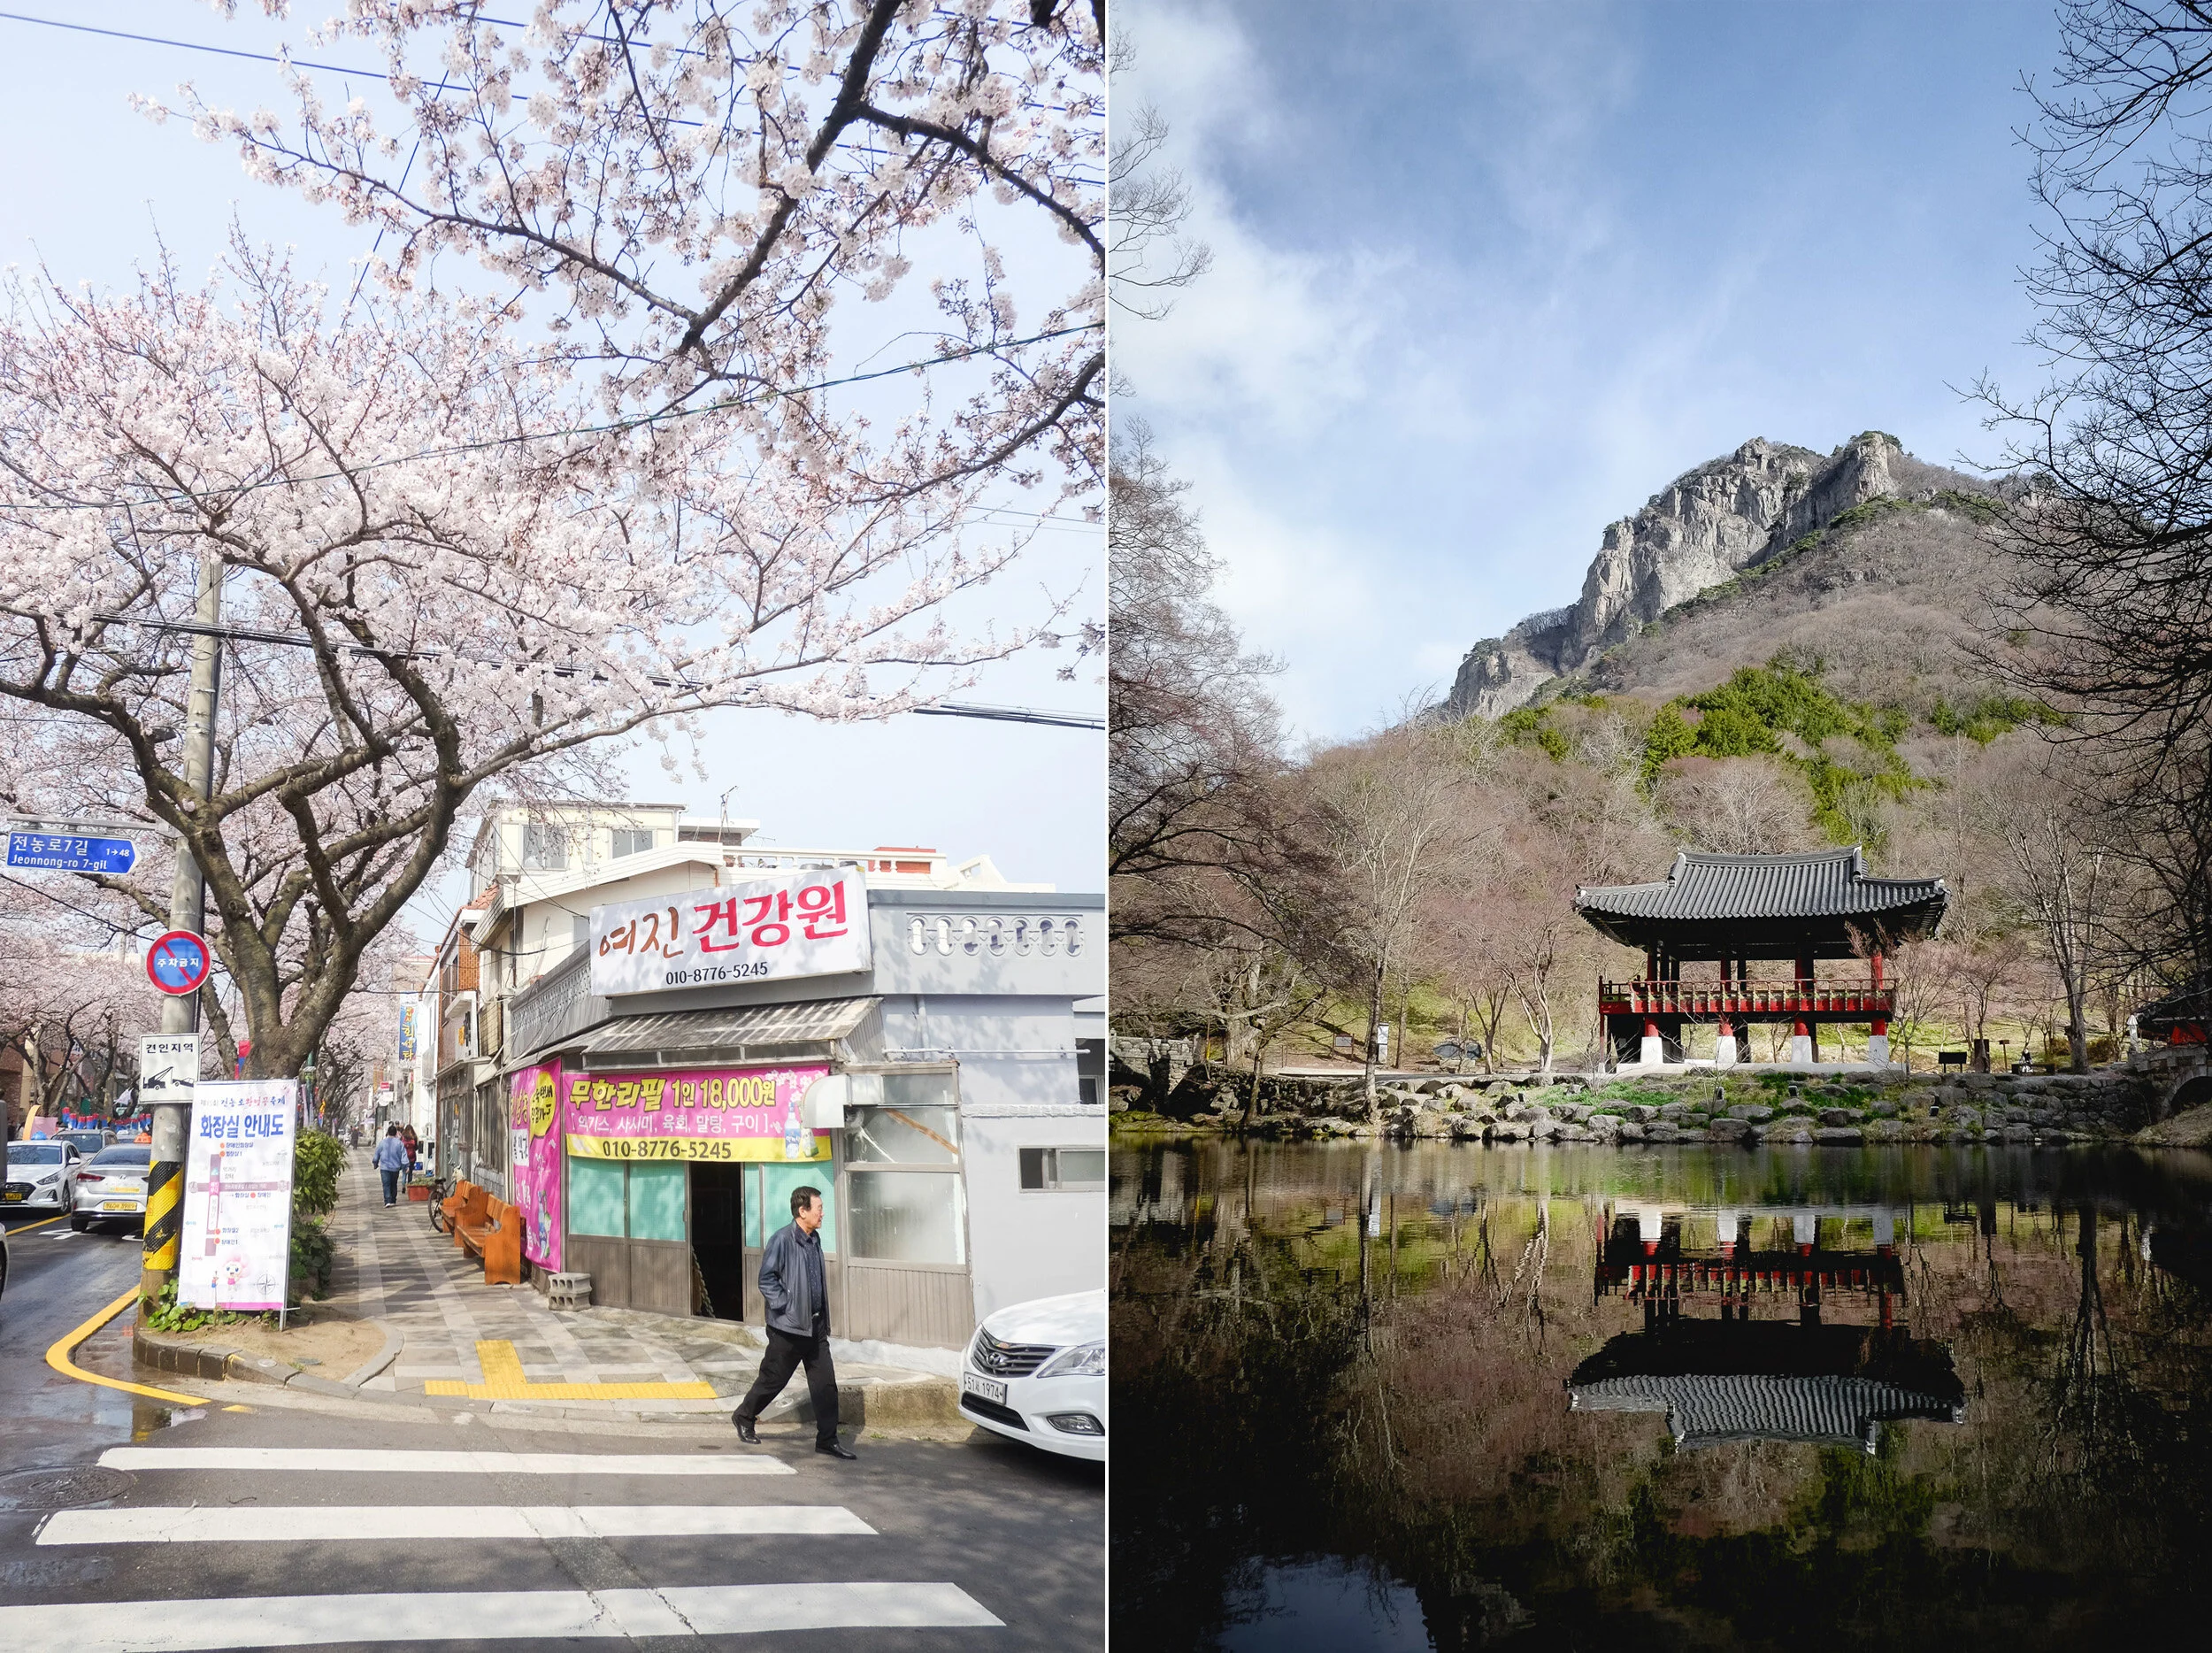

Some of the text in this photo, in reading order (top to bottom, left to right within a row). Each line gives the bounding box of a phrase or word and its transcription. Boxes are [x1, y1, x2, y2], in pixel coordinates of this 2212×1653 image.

[13, 835, 88, 856] 전농로7길
[11, 854, 107, 872] Jeonnong-ro 7-gil
[599, 880, 849, 958] 여진 건강원
[157, 957, 199, 968] 주차금지
[665, 961, 769, 986] 010-8776-5245
[146, 1042, 193, 1054] 견인지역
[568, 1077, 666, 1111] 무한리필
[671, 1078, 696, 1108] 1인
[699, 1075, 777, 1113] 18,000원
[199, 1113, 284, 1139] 화장실 안내도
[617, 1114, 657, 1134] 사시미,
[663, 1113, 691, 1134] 육회,
[696, 1113, 726, 1134] 말탕,
[731, 1114, 759, 1134] 구이
[602, 1139, 732, 1160] 010-8776-5245
